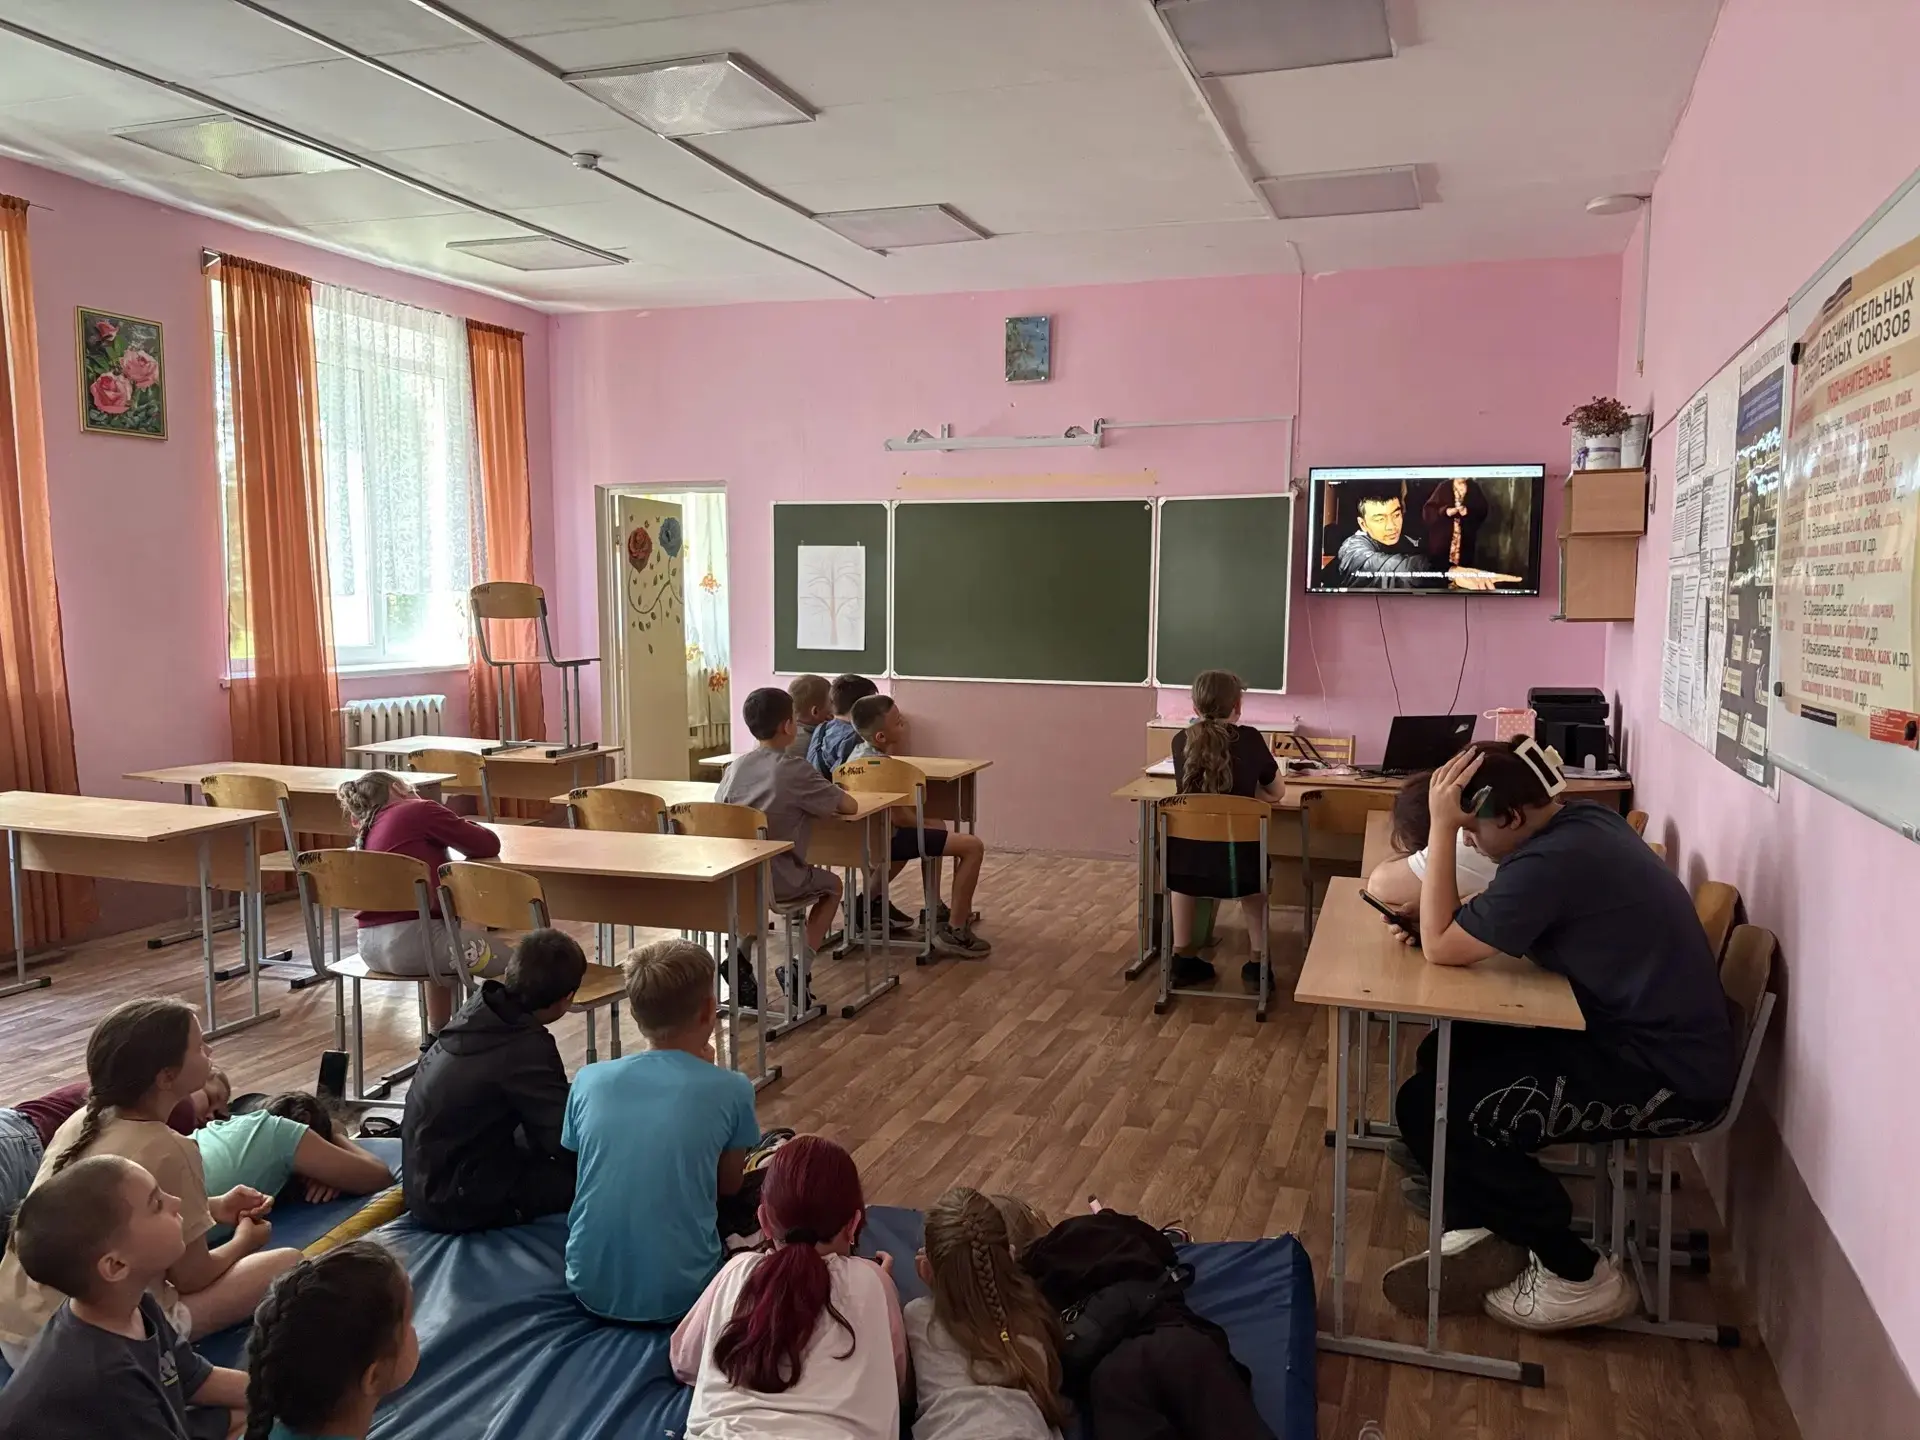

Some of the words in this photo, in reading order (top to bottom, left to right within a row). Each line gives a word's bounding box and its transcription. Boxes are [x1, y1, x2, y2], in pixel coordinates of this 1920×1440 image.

[1857, 309, 1911, 354] СОЮЗОВ
[1892, 651, 1898, 666] и
[1898, 651, 1912, 672] др.
